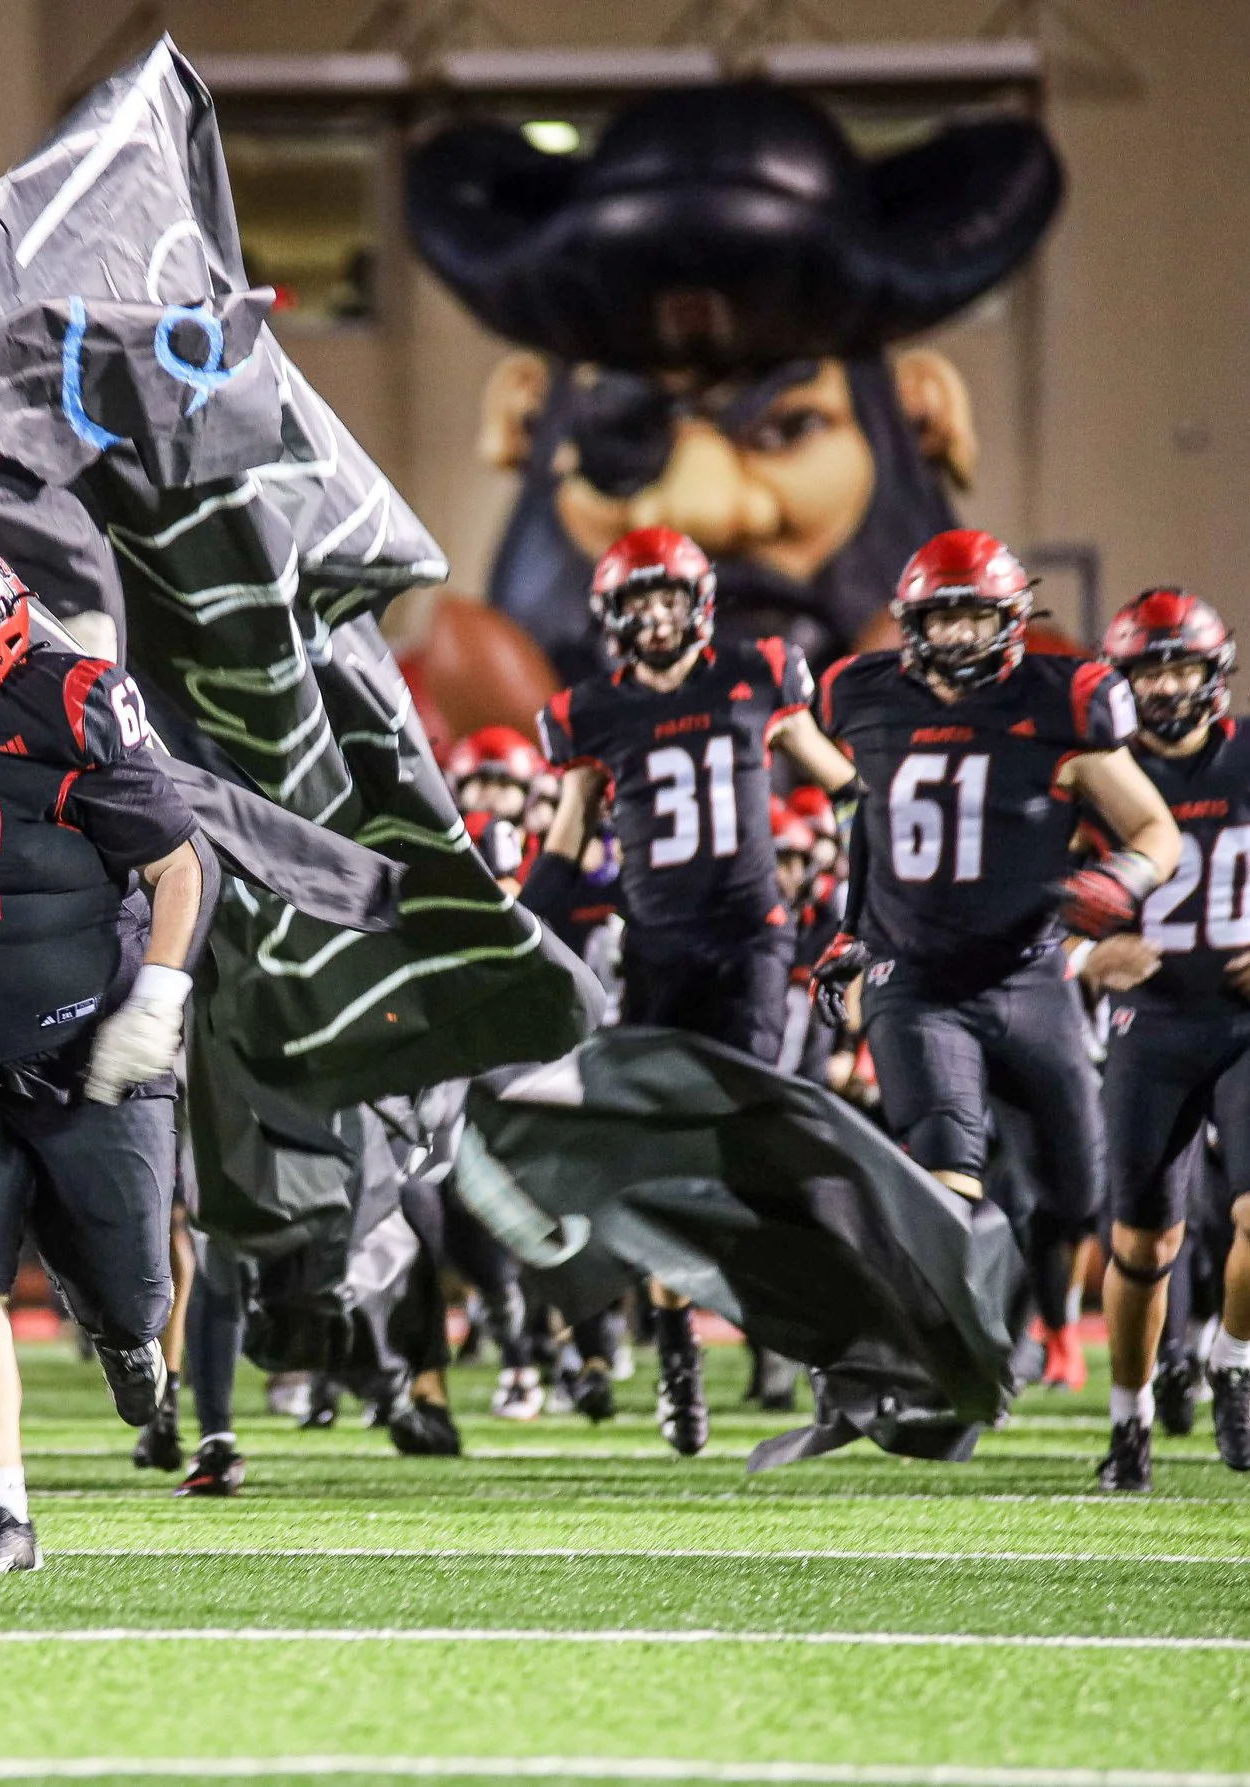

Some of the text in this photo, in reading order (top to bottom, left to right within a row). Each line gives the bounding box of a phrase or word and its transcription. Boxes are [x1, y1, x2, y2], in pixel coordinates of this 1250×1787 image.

[110, 675, 151, 748] 62
[646, 734, 739, 870] 31
[888, 752, 992, 884] 61
[1141, 823, 1250, 955] 20
